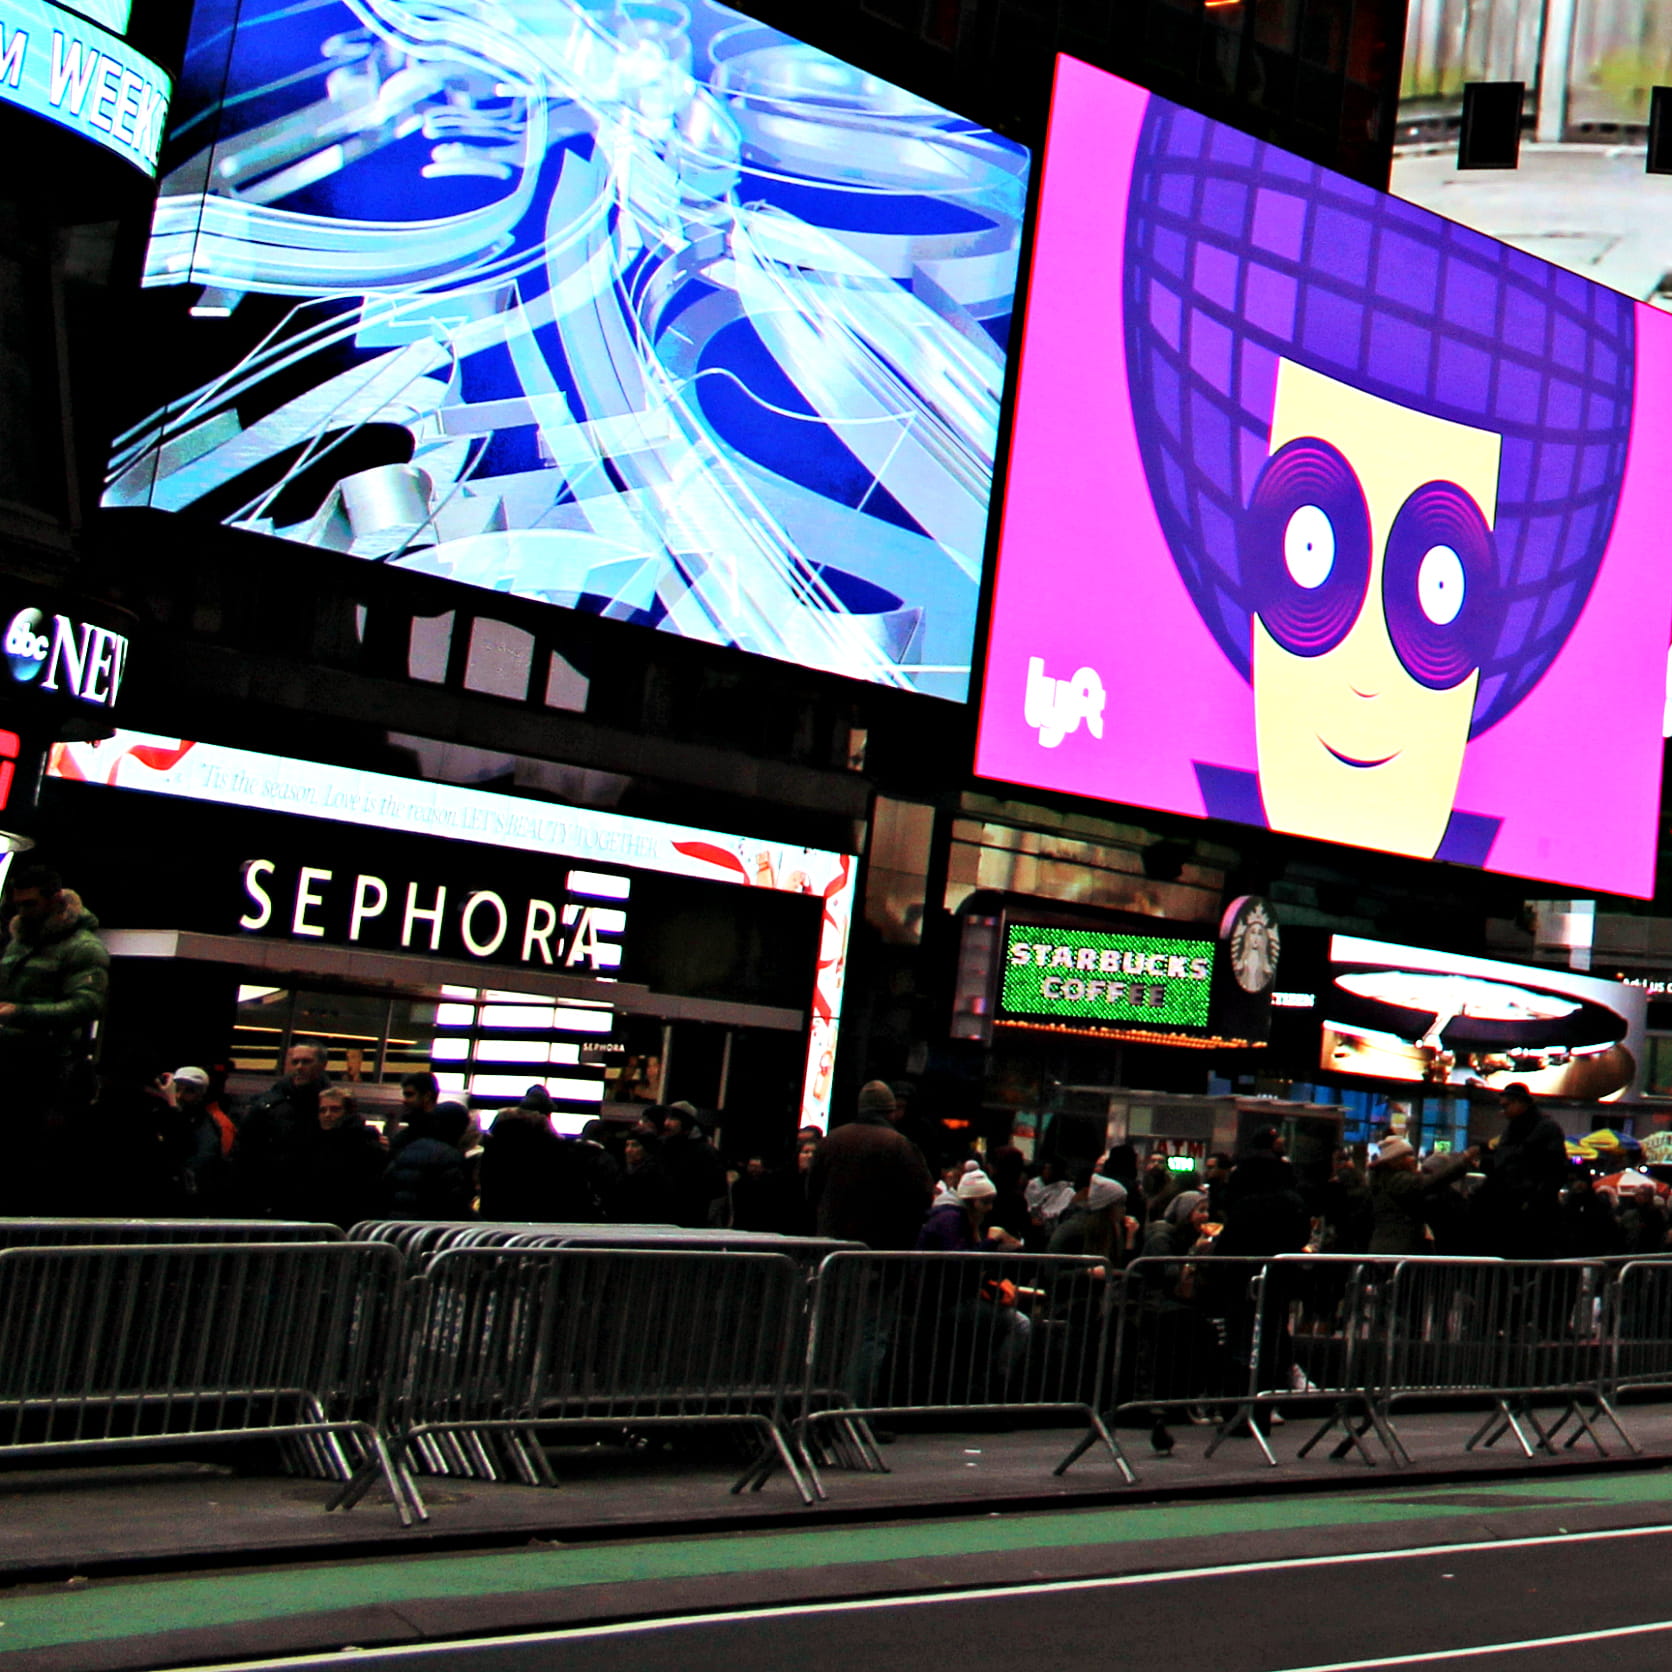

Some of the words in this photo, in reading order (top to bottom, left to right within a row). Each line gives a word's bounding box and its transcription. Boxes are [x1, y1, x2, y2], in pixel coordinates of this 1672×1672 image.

[239, 858, 602, 971] SEPHORA
[1010, 941, 1210, 981] STARBUCKS
[1042, 975, 1166, 1009] COFFEE
